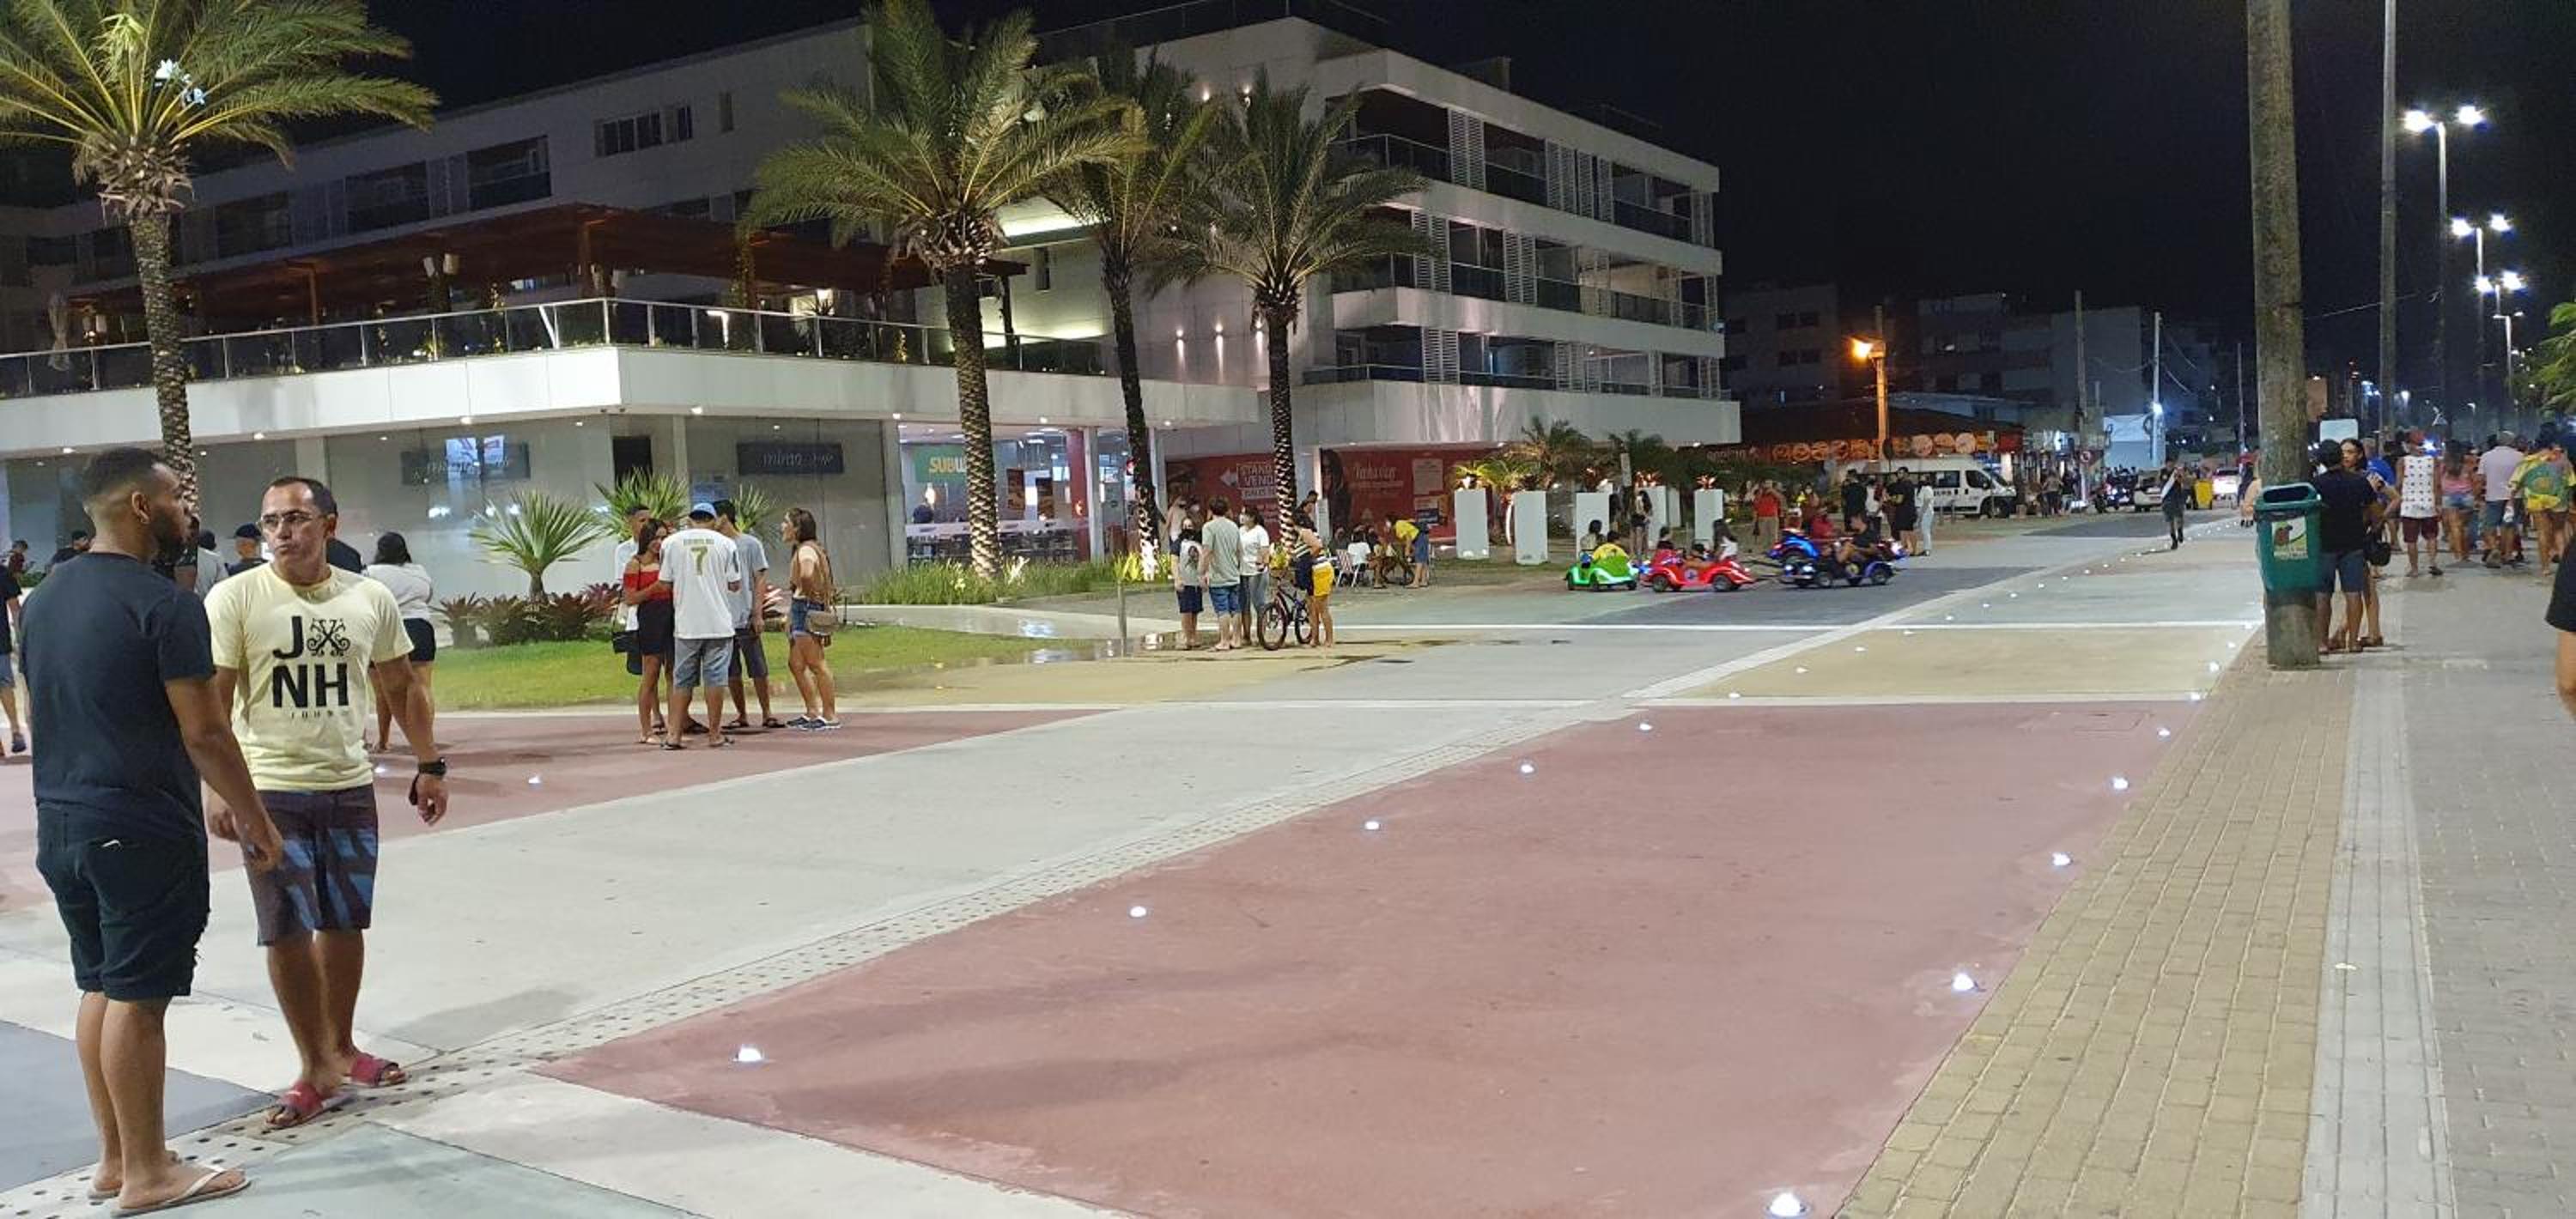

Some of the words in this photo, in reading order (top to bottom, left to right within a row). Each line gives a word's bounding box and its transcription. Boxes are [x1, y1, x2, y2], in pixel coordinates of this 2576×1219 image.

[929, 456, 966, 473] SUBW
[1245, 475, 1278, 487] VEND
[690, 546, 708, 575] 7
[272, 662, 349, 708] NH
